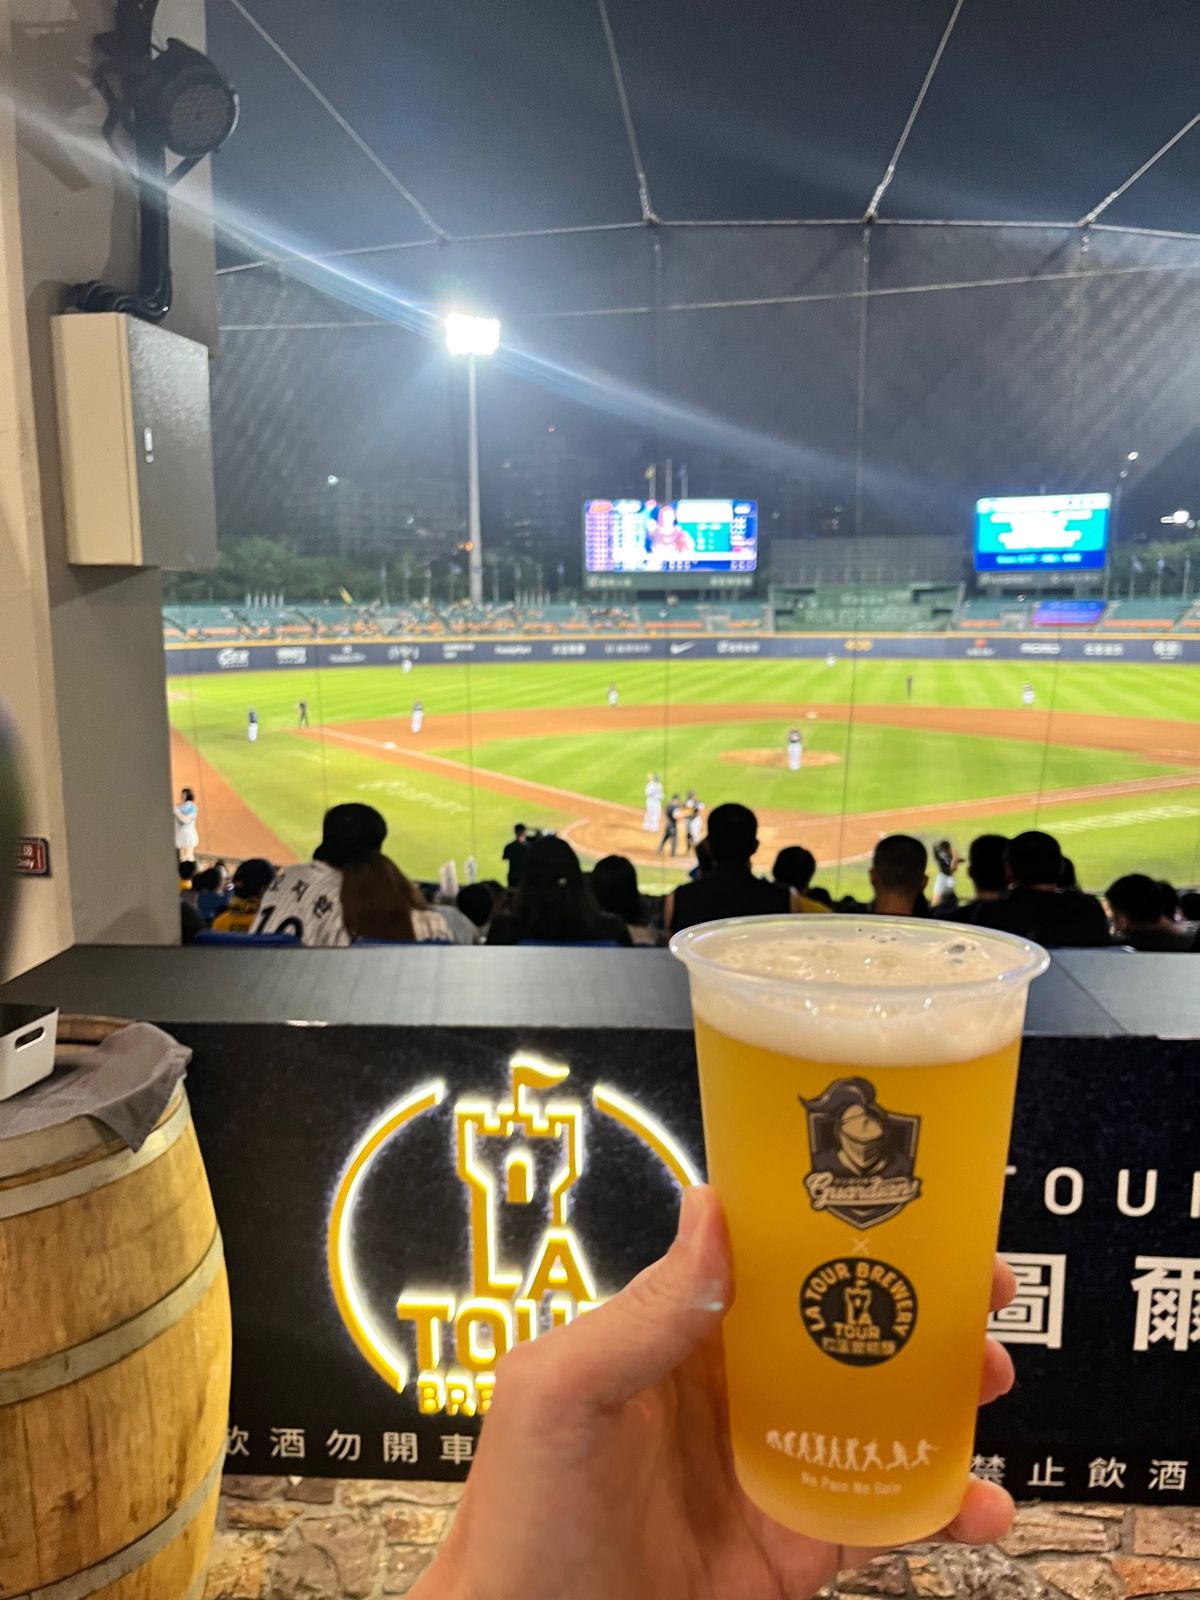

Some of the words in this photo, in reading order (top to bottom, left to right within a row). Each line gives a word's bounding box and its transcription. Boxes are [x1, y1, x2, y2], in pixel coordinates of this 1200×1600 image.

[1005, 1165, 1200, 1219] OU
[804, 1262, 851, 1300] TOUR
[855, 1261, 914, 1337] BREWERY
[804, 1305, 827, 1332] LA
[833, 1321, 881, 1339] TOUR
[417, 1369, 497, 1418] BRE
